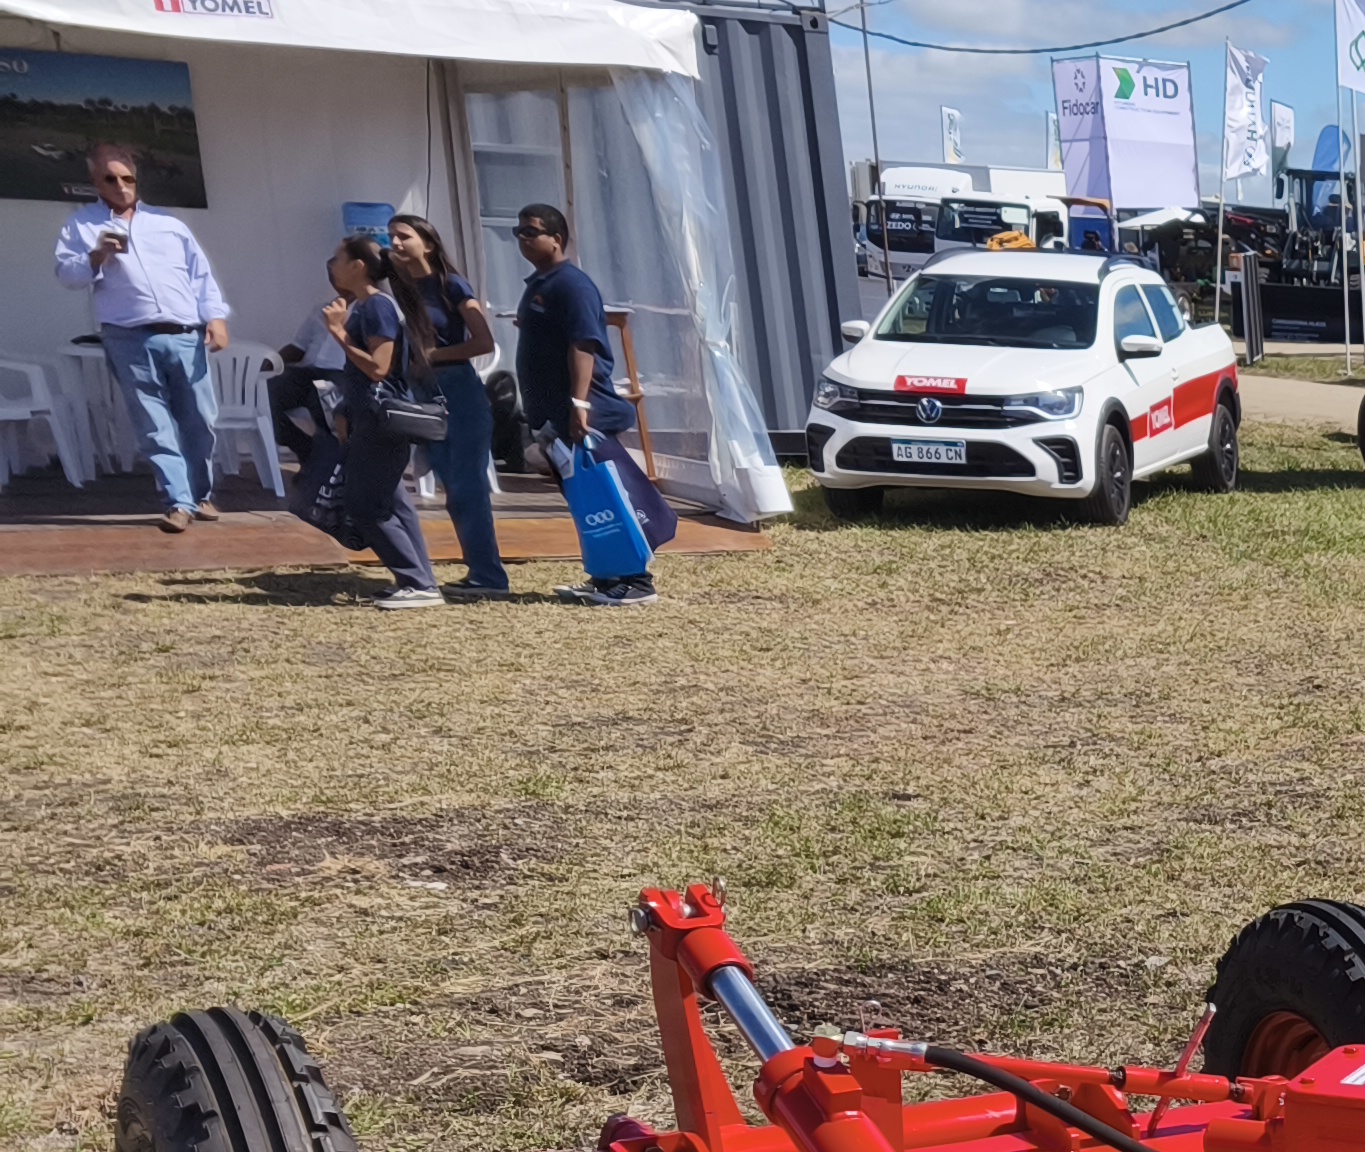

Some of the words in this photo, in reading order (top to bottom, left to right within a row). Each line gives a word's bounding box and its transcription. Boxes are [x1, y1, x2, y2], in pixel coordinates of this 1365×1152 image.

[1142, 75, 1179, 99] HD
[1061, 99, 1099, 117] Fidocar
[904, 376, 958, 389] YOMEL
[896, 446, 912, 459] AG
[917, 447, 941, 460] 866
[946, 448, 963, 461] CN
